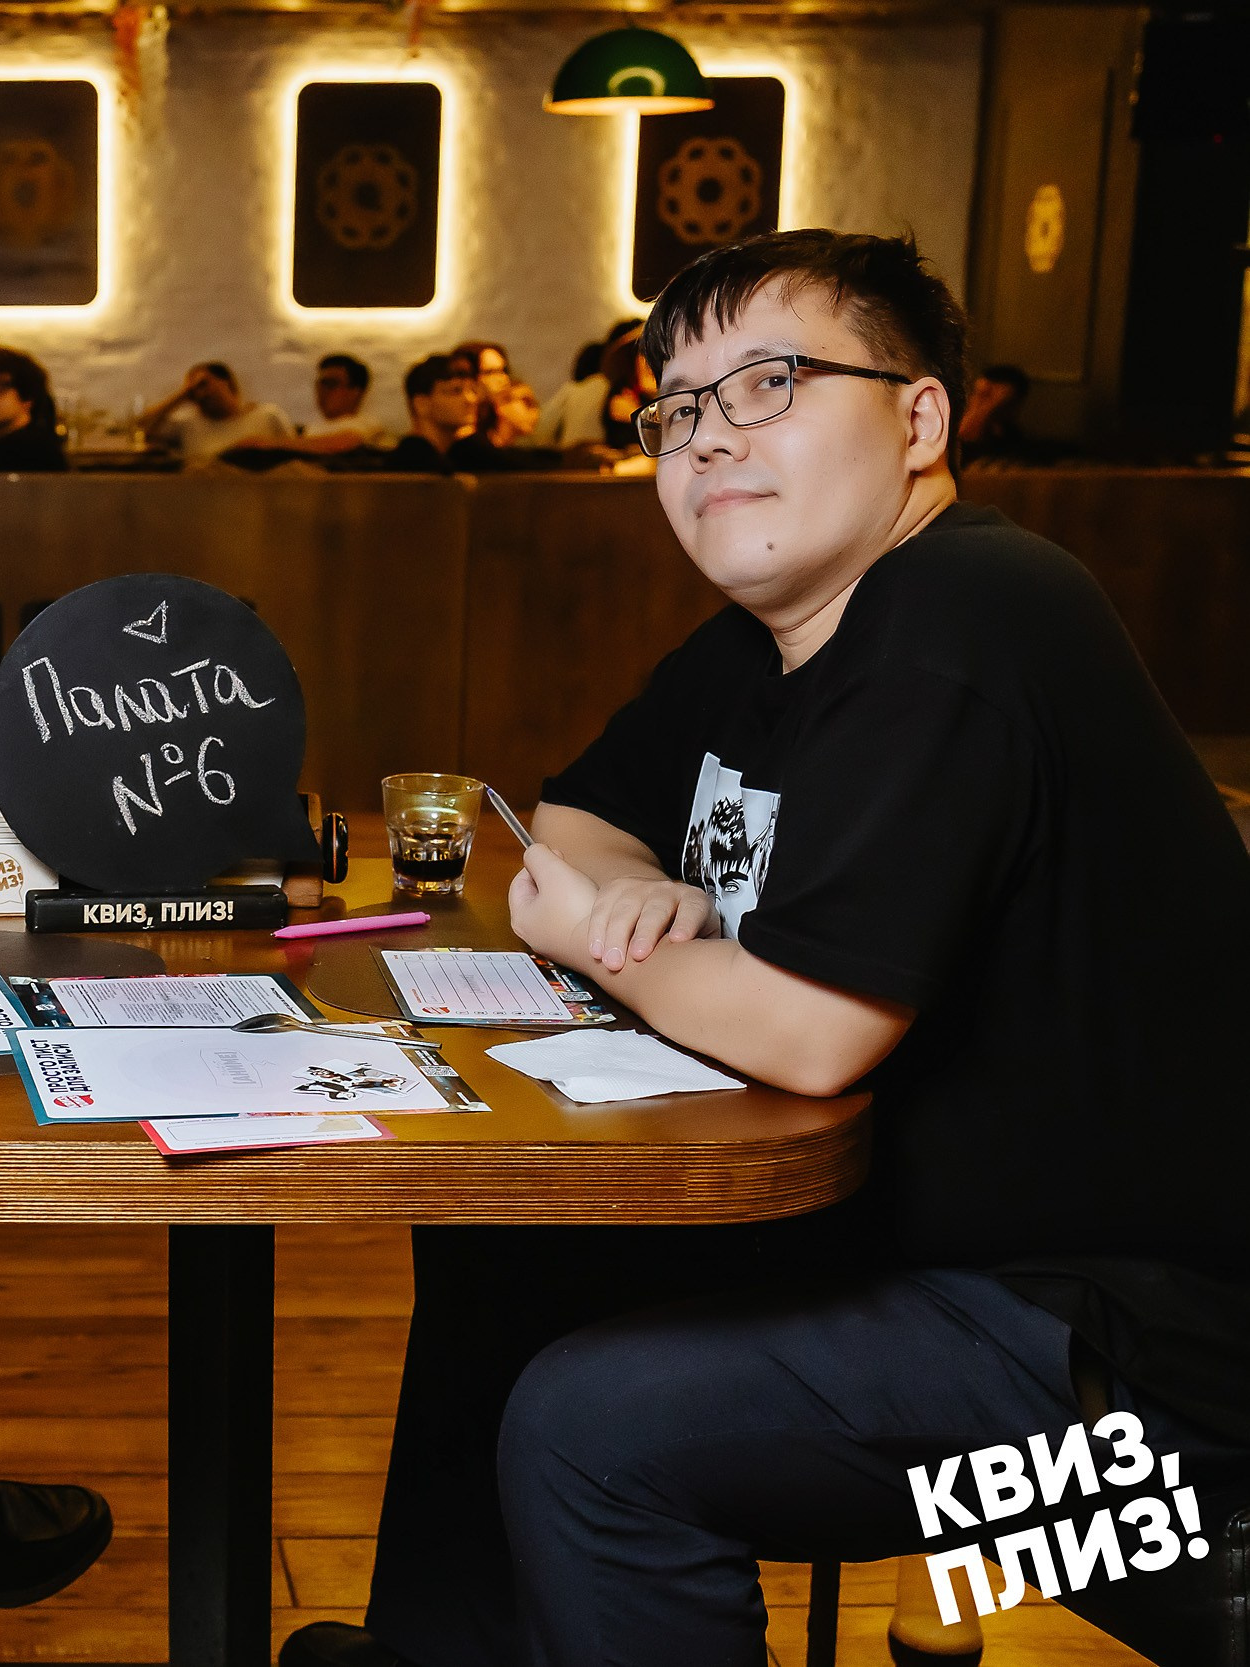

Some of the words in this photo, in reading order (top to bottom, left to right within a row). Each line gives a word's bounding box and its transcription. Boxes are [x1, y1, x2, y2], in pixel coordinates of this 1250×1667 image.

[21, 656, 276, 744] Палата
[83, 903, 154, 928] КВИЗ,
[160, 901, 235, 924] ПЛИЗ!
[30, 1039, 55, 1059] ЛИСТ
[51, 1043, 81, 1075] ЗАПИСИ
[38, 1060, 69, 1093] ПРОСТО
[64, 1075, 93, 1092] ДЛЯ
